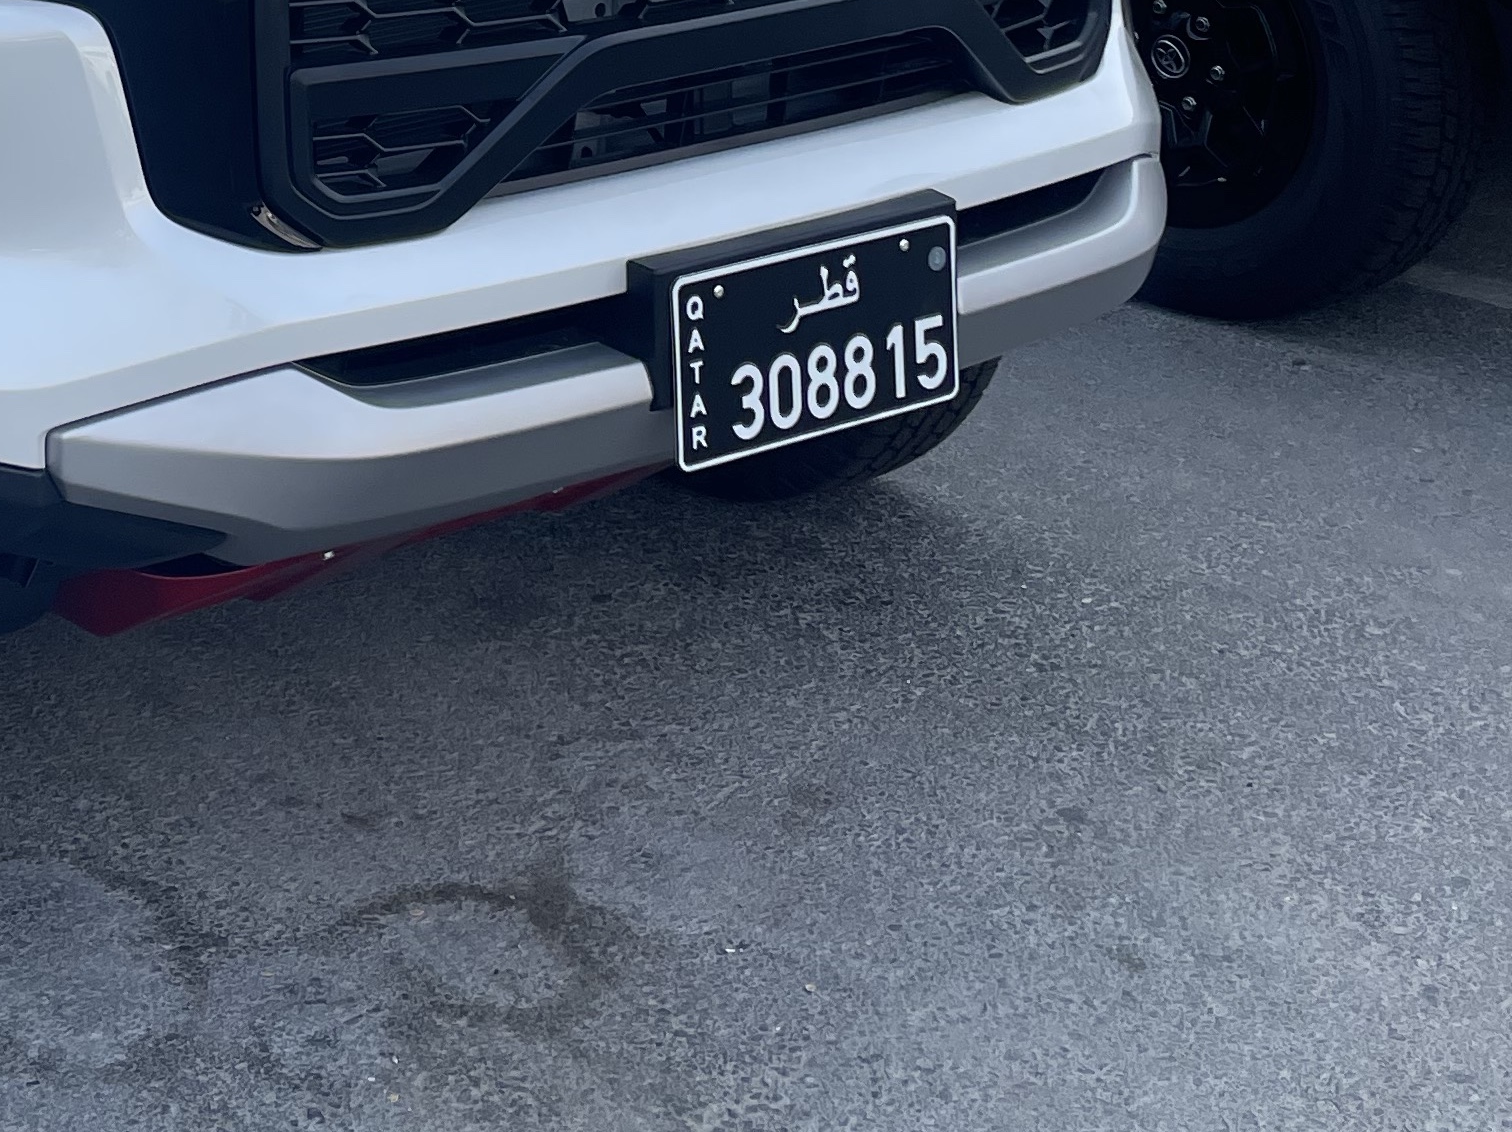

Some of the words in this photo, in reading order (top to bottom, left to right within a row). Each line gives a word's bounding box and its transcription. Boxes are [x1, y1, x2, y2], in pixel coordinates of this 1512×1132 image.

[776, 253, 860, 333] قطر
[685, 295, 709, 451] QATAR
[730, 314, 948, 441] 308815
